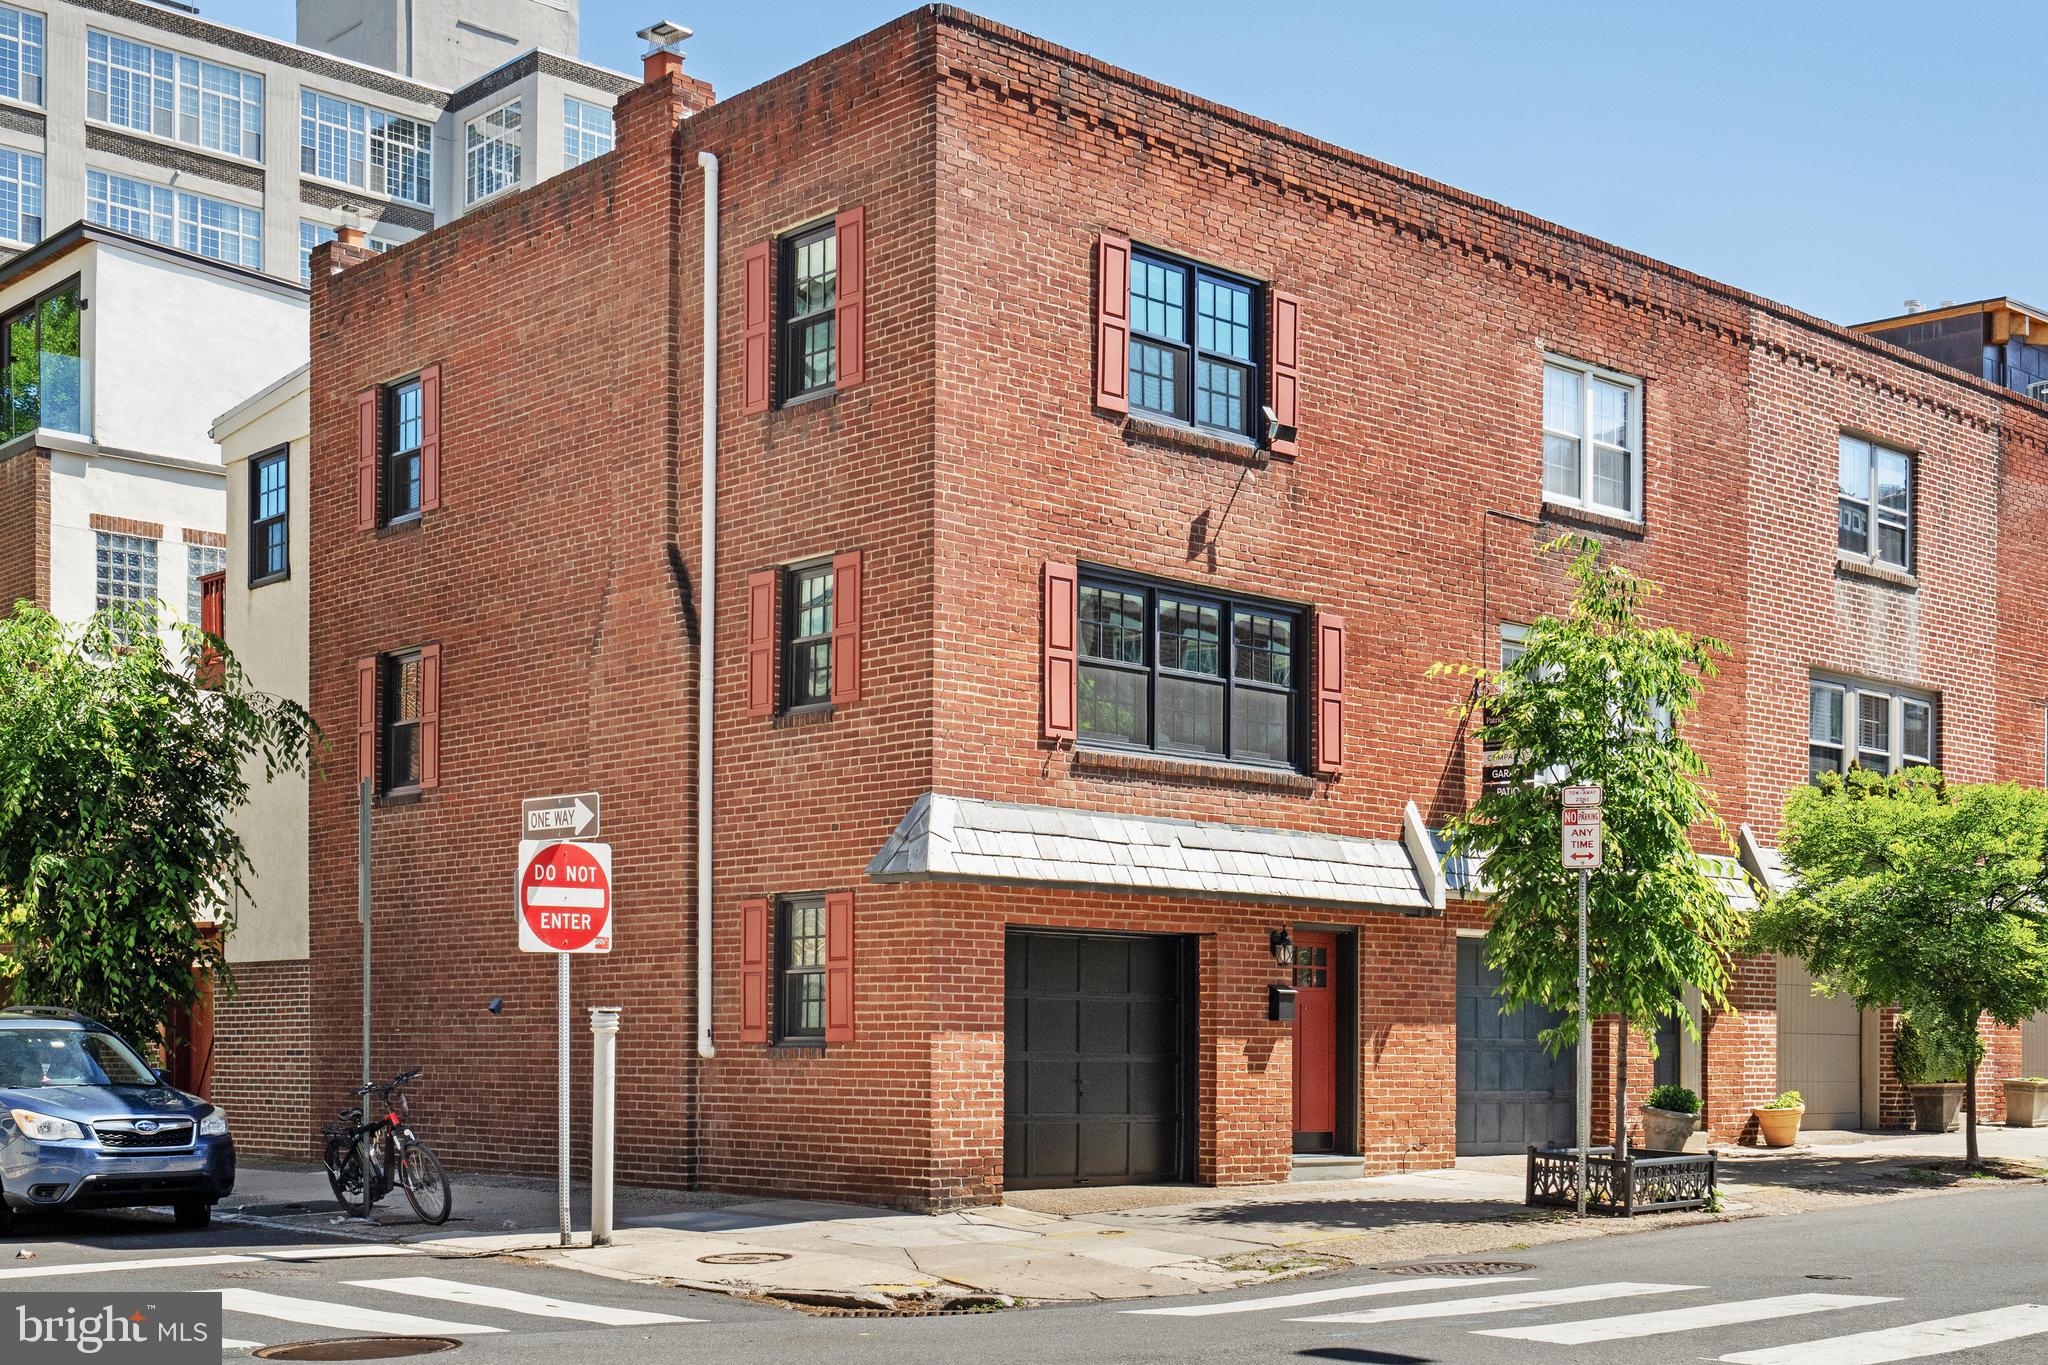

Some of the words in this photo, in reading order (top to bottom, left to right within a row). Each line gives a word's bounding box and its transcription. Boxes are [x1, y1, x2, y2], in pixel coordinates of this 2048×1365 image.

[1496, 786, 1521, 797] PATIO
[530, 811, 550, 828] ONE
[554, 808, 575, 826] WAY
[1564, 811, 1577, 823] NO
[1578, 812, 1599, 821] PARKING
[1571, 829, 1594, 837] ANY
[1571, 840, 1594, 849] TIME
[534, 863, 556, 881] DO
[566, 866, 597, 883] NOT
[540, 912, 591, 930] ENTER
